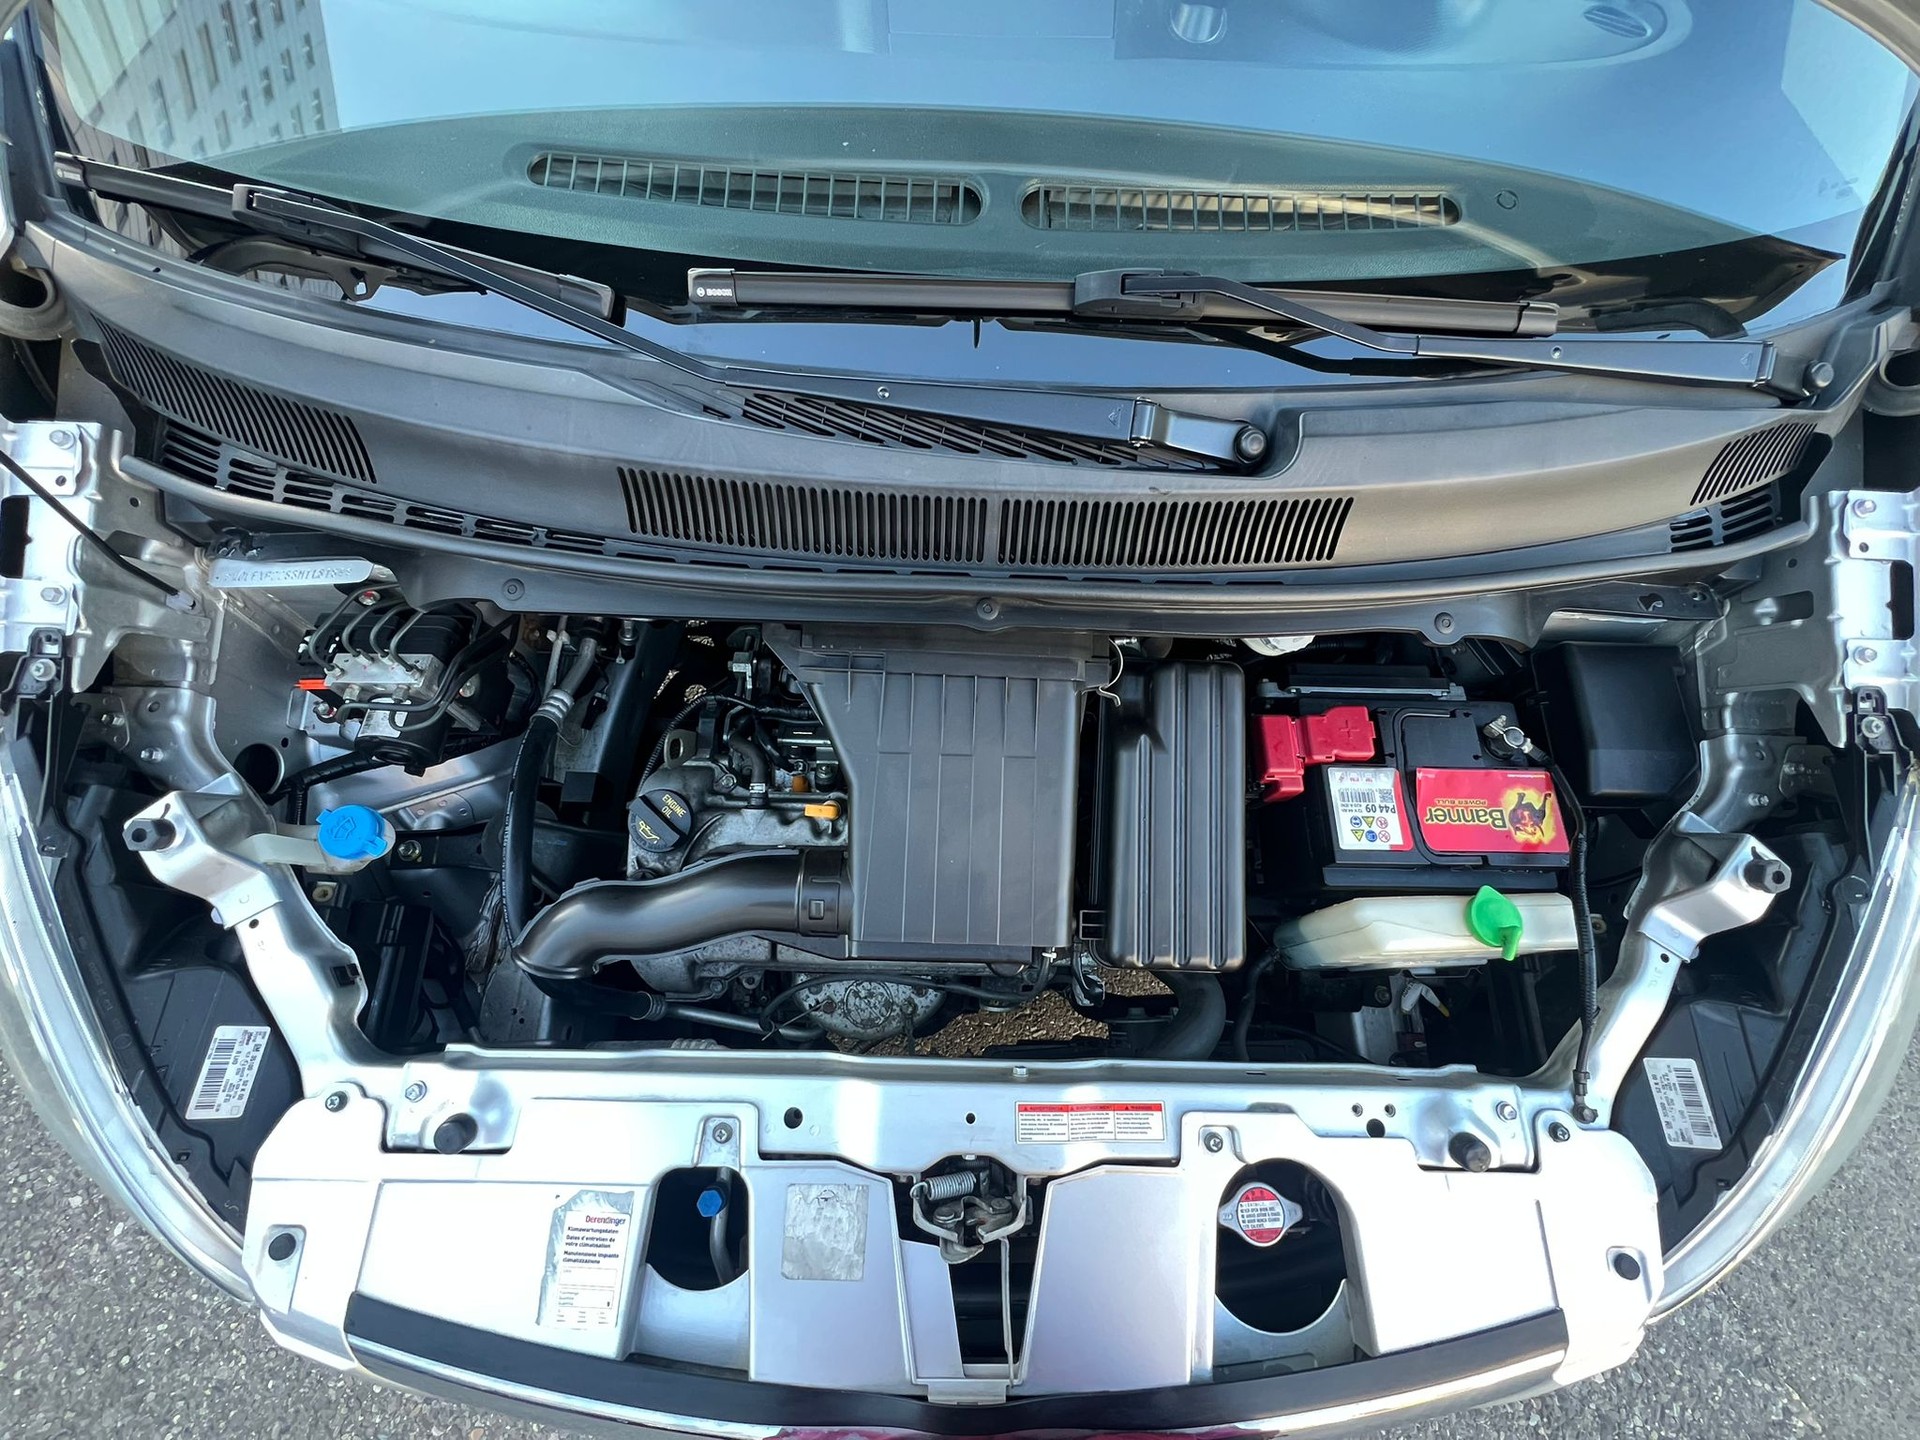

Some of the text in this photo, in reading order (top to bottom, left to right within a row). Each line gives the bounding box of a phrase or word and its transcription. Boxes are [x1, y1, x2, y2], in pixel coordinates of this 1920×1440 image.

[662, 794, 686, 817] ENGINE
[662, 805, 672, 818] OIL
[1366, 804, 1396, 813] P44 09
[1425, 806, 1508, 830] Banner
[586, 1215, 626, 1226] Derendinger
